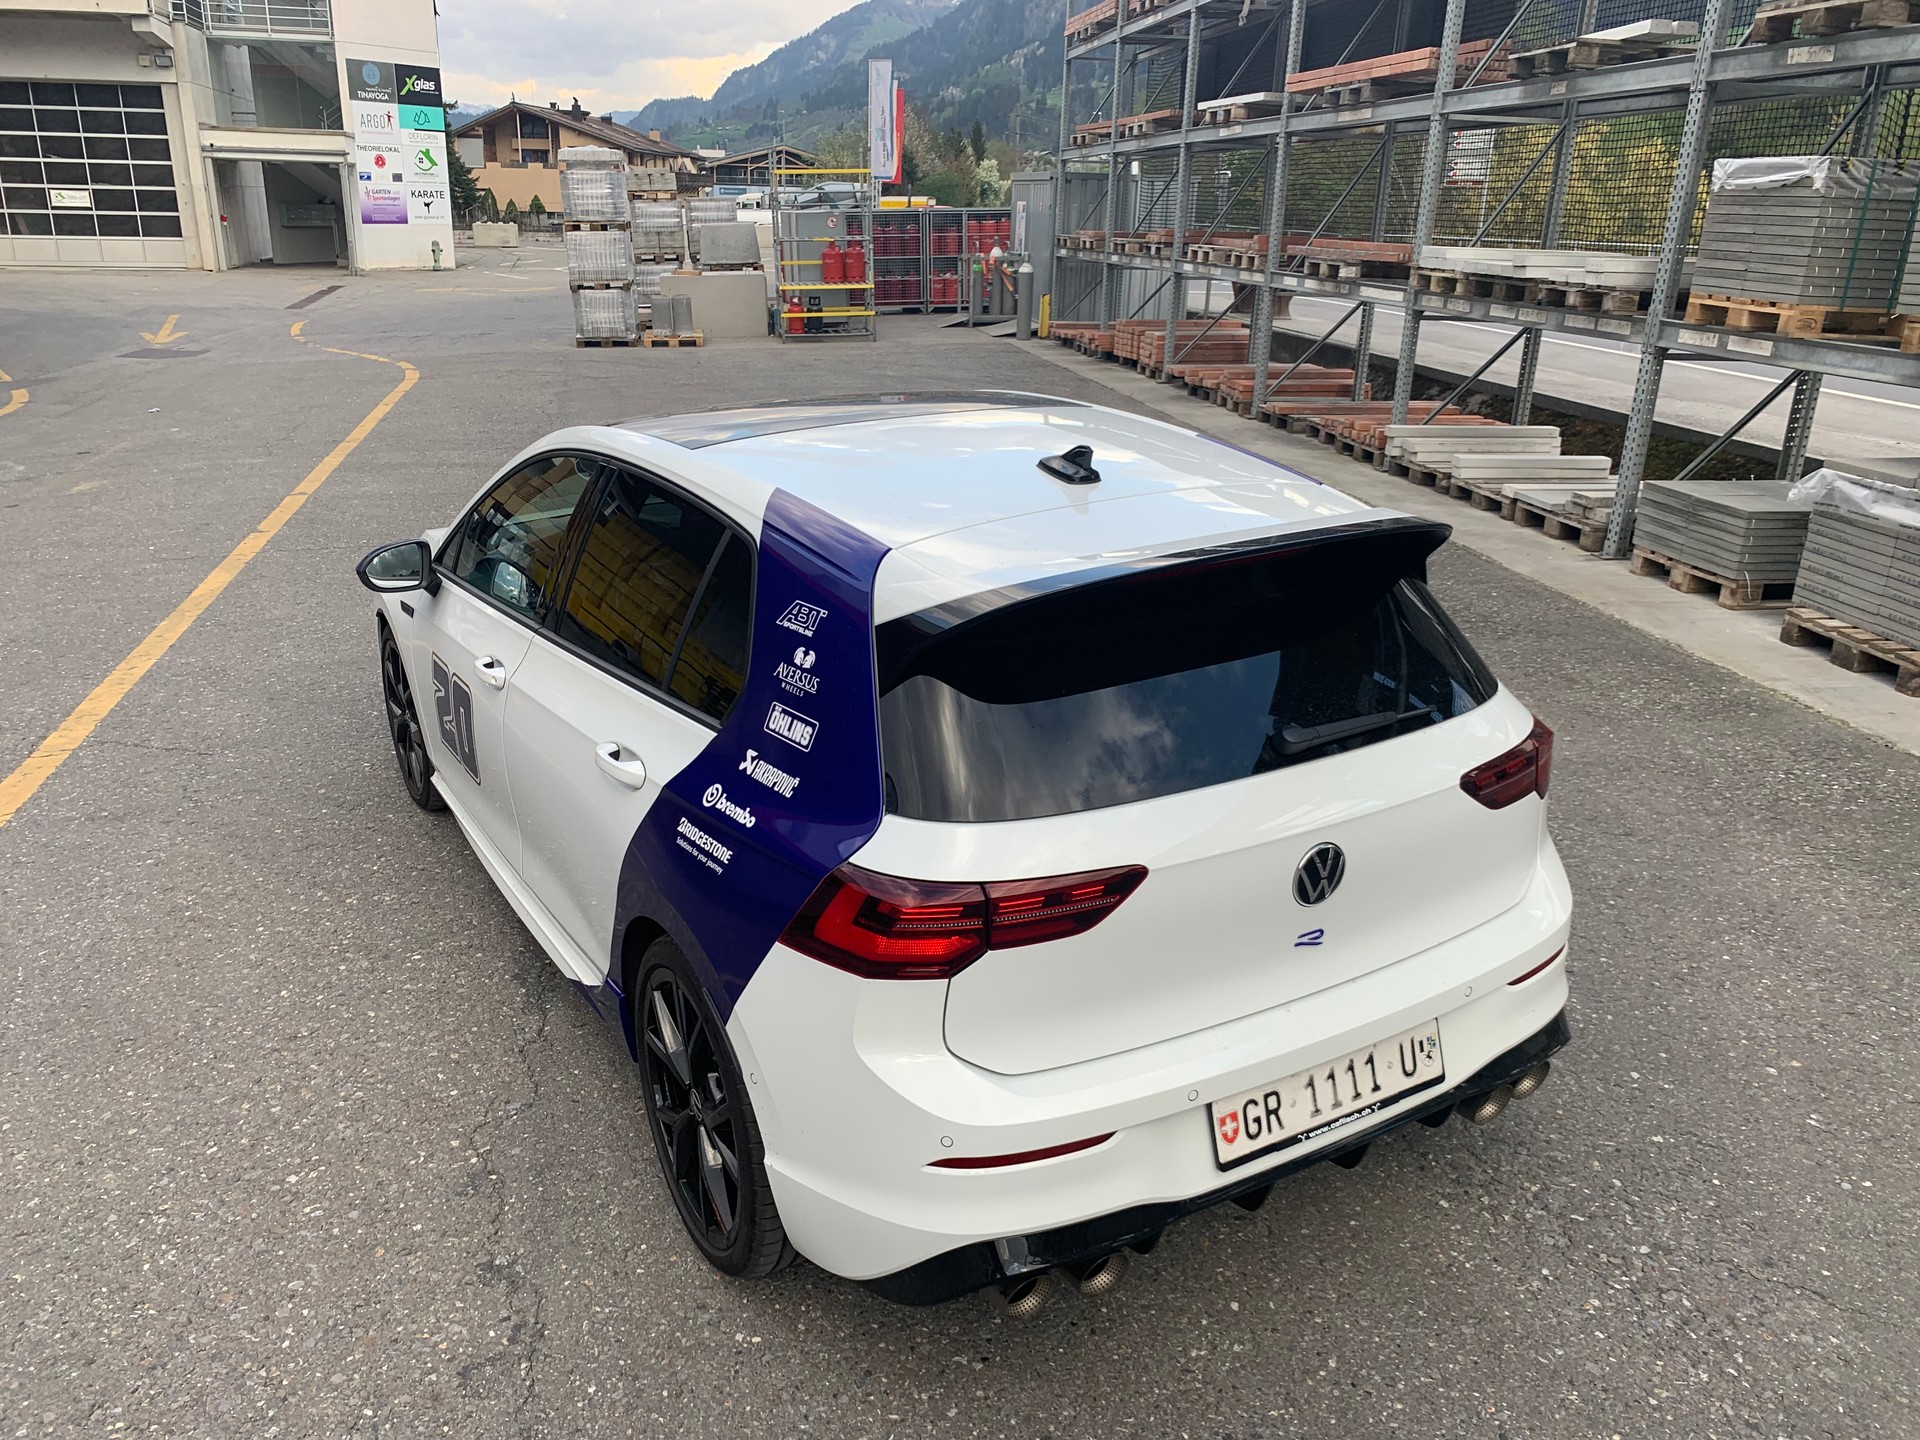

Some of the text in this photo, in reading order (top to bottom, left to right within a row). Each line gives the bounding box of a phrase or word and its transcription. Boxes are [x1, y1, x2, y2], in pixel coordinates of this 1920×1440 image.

[357, 90, 390, 101] TINAYOGA
[400, 74, 435, 96] Xglas
[360, 113, 386, 129] ARGO
[408, 132, 439, 141] DEFLORIN
[356, 144, 401, 154] THEORIELOKAL
[410, 189, 446, 200] KARATE
[776, 600, 829, 631] ABT
[783, 620, 814, 638] SPORTSLINE
[773, 661, 820, 692] AVERSUS
[781, 681, 804, 697] WHEELS
[768, 705, 813, 746] ÖHLINS
[715, 793, 756, 828] brembo
[677, 816, 733, 864] BRIDGESTONE
[676, 836, 693, 853] Solutions
[696, 853, 708, 863] your
[705, 858, 724, 875] journey
[1242, 1036, 1417, 1141] GR 1111 U
